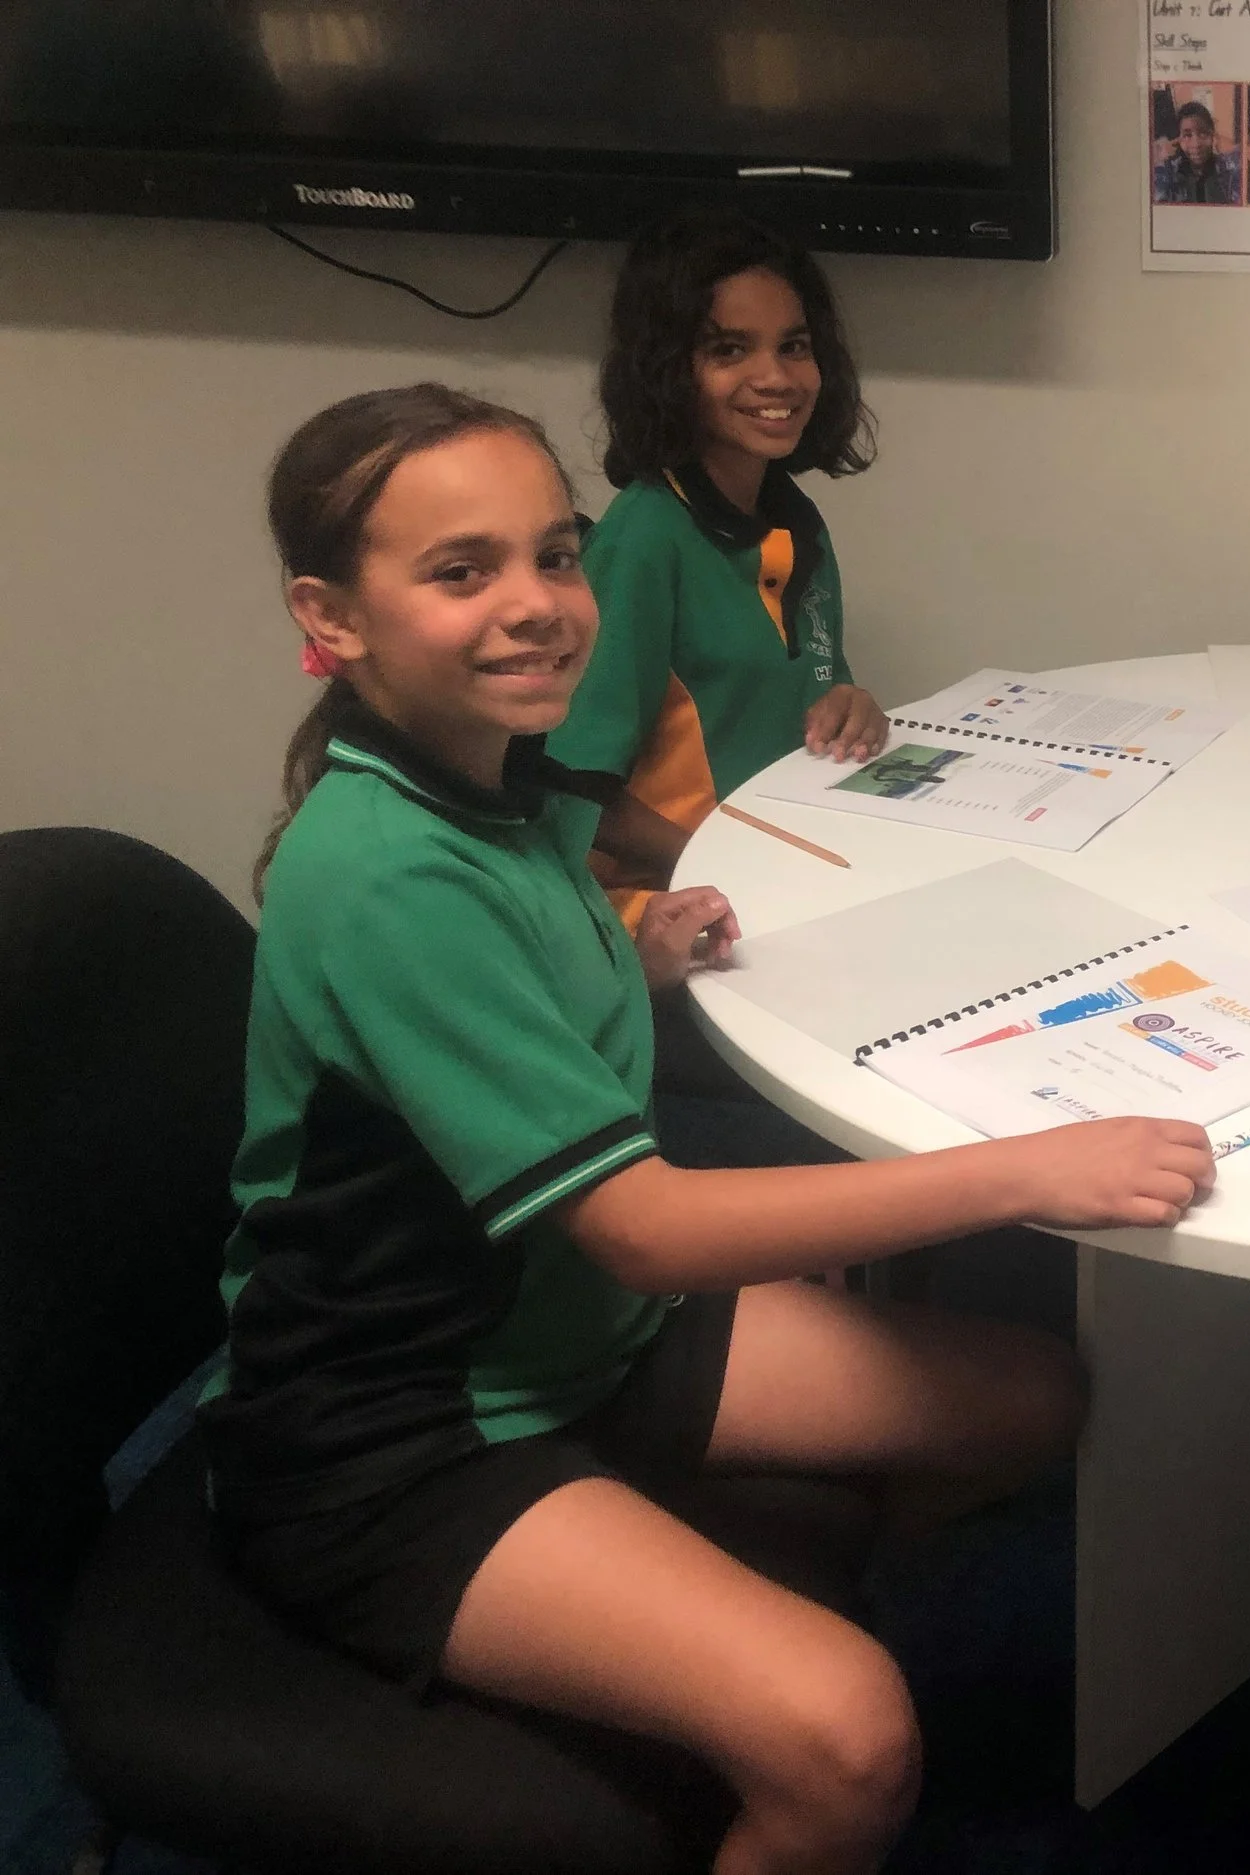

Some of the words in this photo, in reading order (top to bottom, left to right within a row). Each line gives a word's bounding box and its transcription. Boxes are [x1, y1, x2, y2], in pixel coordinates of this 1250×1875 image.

[1152, 0, 1183, 17] Unit
[1208, 0, 1232, 17] Get
[1171, 1026, 1246, 1061] ASPIRE
